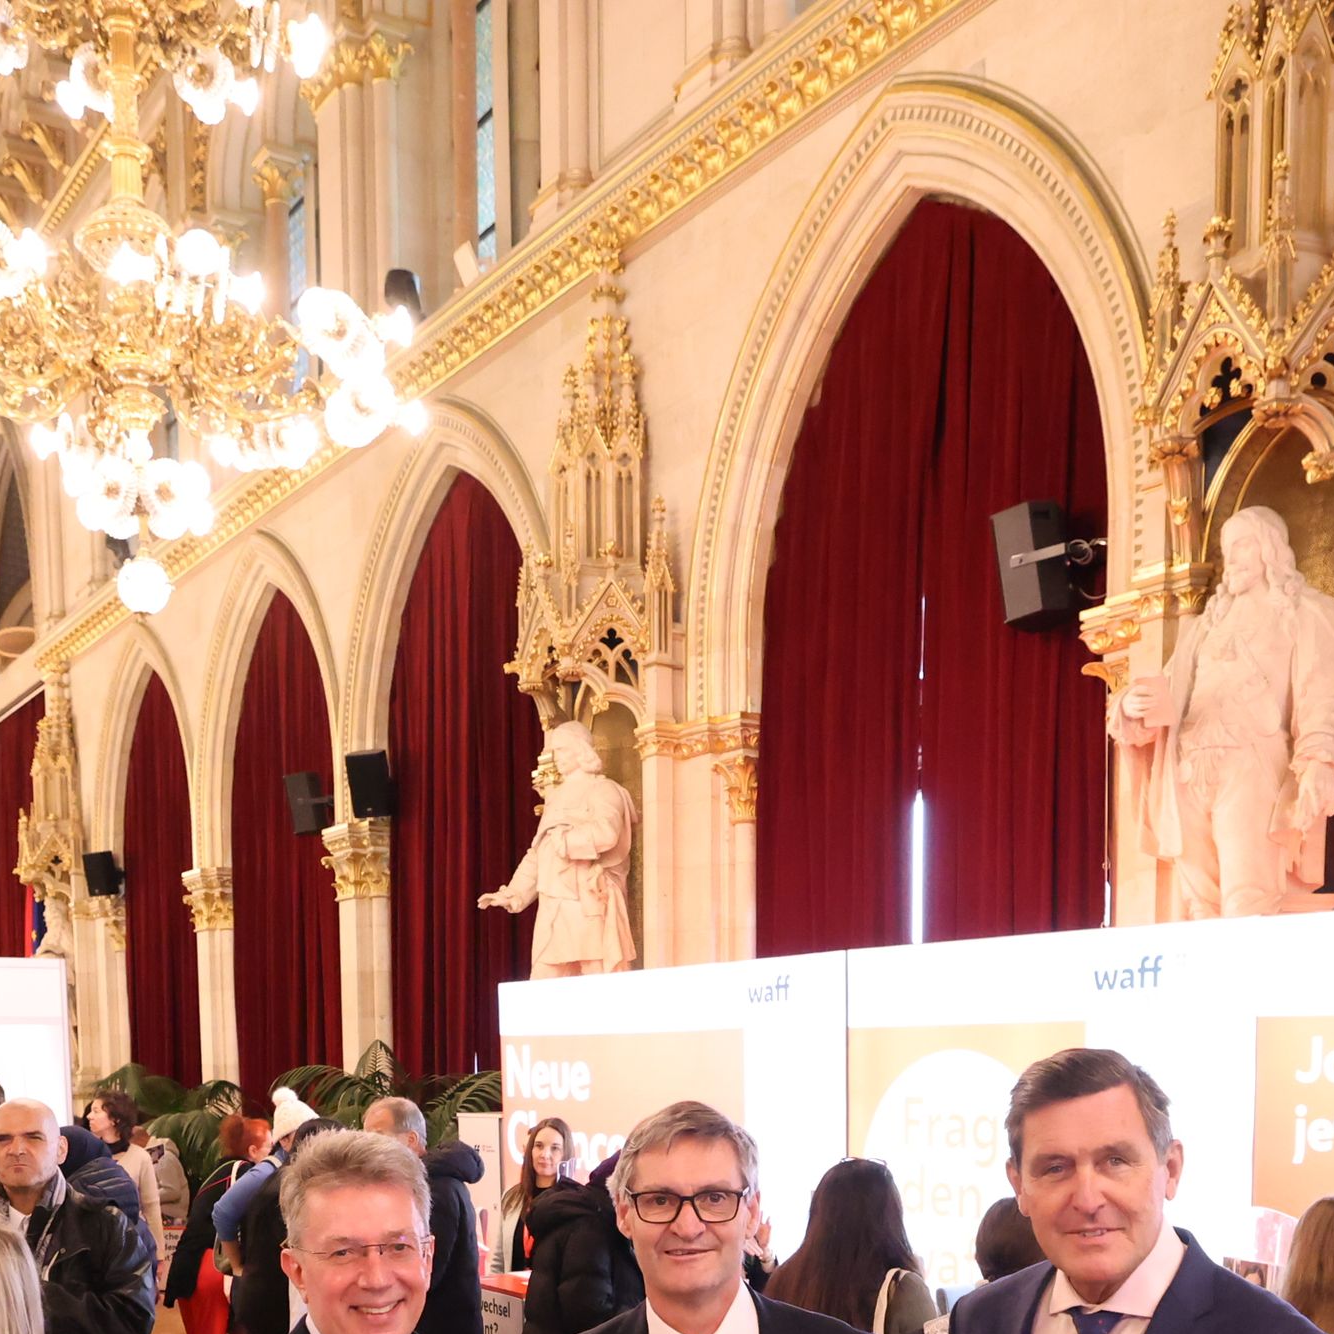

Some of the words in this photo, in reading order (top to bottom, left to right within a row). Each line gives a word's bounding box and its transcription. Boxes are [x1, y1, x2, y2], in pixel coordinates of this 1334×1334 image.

[747, 975, 790, 1004] waff
[1093, 955, 1163, 991] waff
[505, 1043, 592, 1102] Neue
[904, 1096, 999, 1168] Frag
[902, 1165, 983, 1218] den
